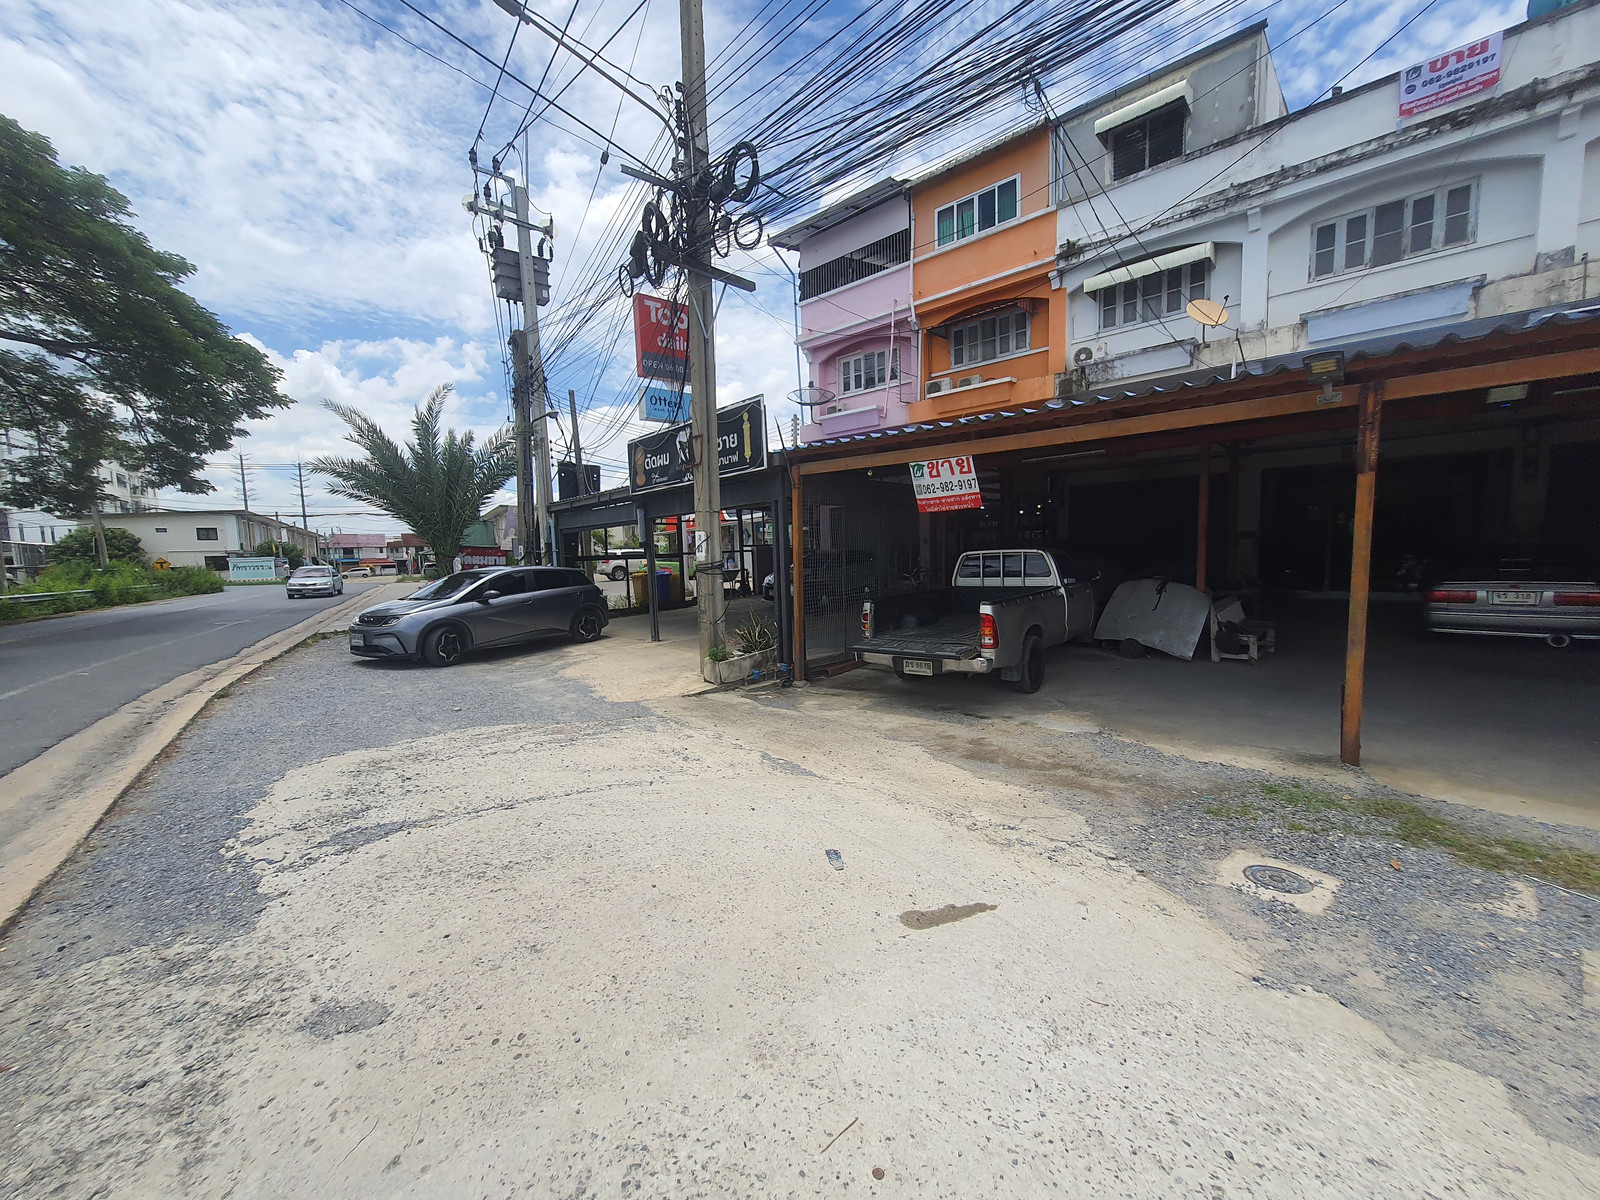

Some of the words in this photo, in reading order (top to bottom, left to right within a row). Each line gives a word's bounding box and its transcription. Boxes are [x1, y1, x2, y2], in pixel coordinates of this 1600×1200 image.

[1422, 53, 1497, 88] 062-9829197
[643, 299, 688, 334] Top
[642, 359, 663, 370] OPEN
[644, 452, 670, 470] ตัดผม
[926, 456, 973, 479] ขาย
[922, 478, 977, 495] 062-982-9197
